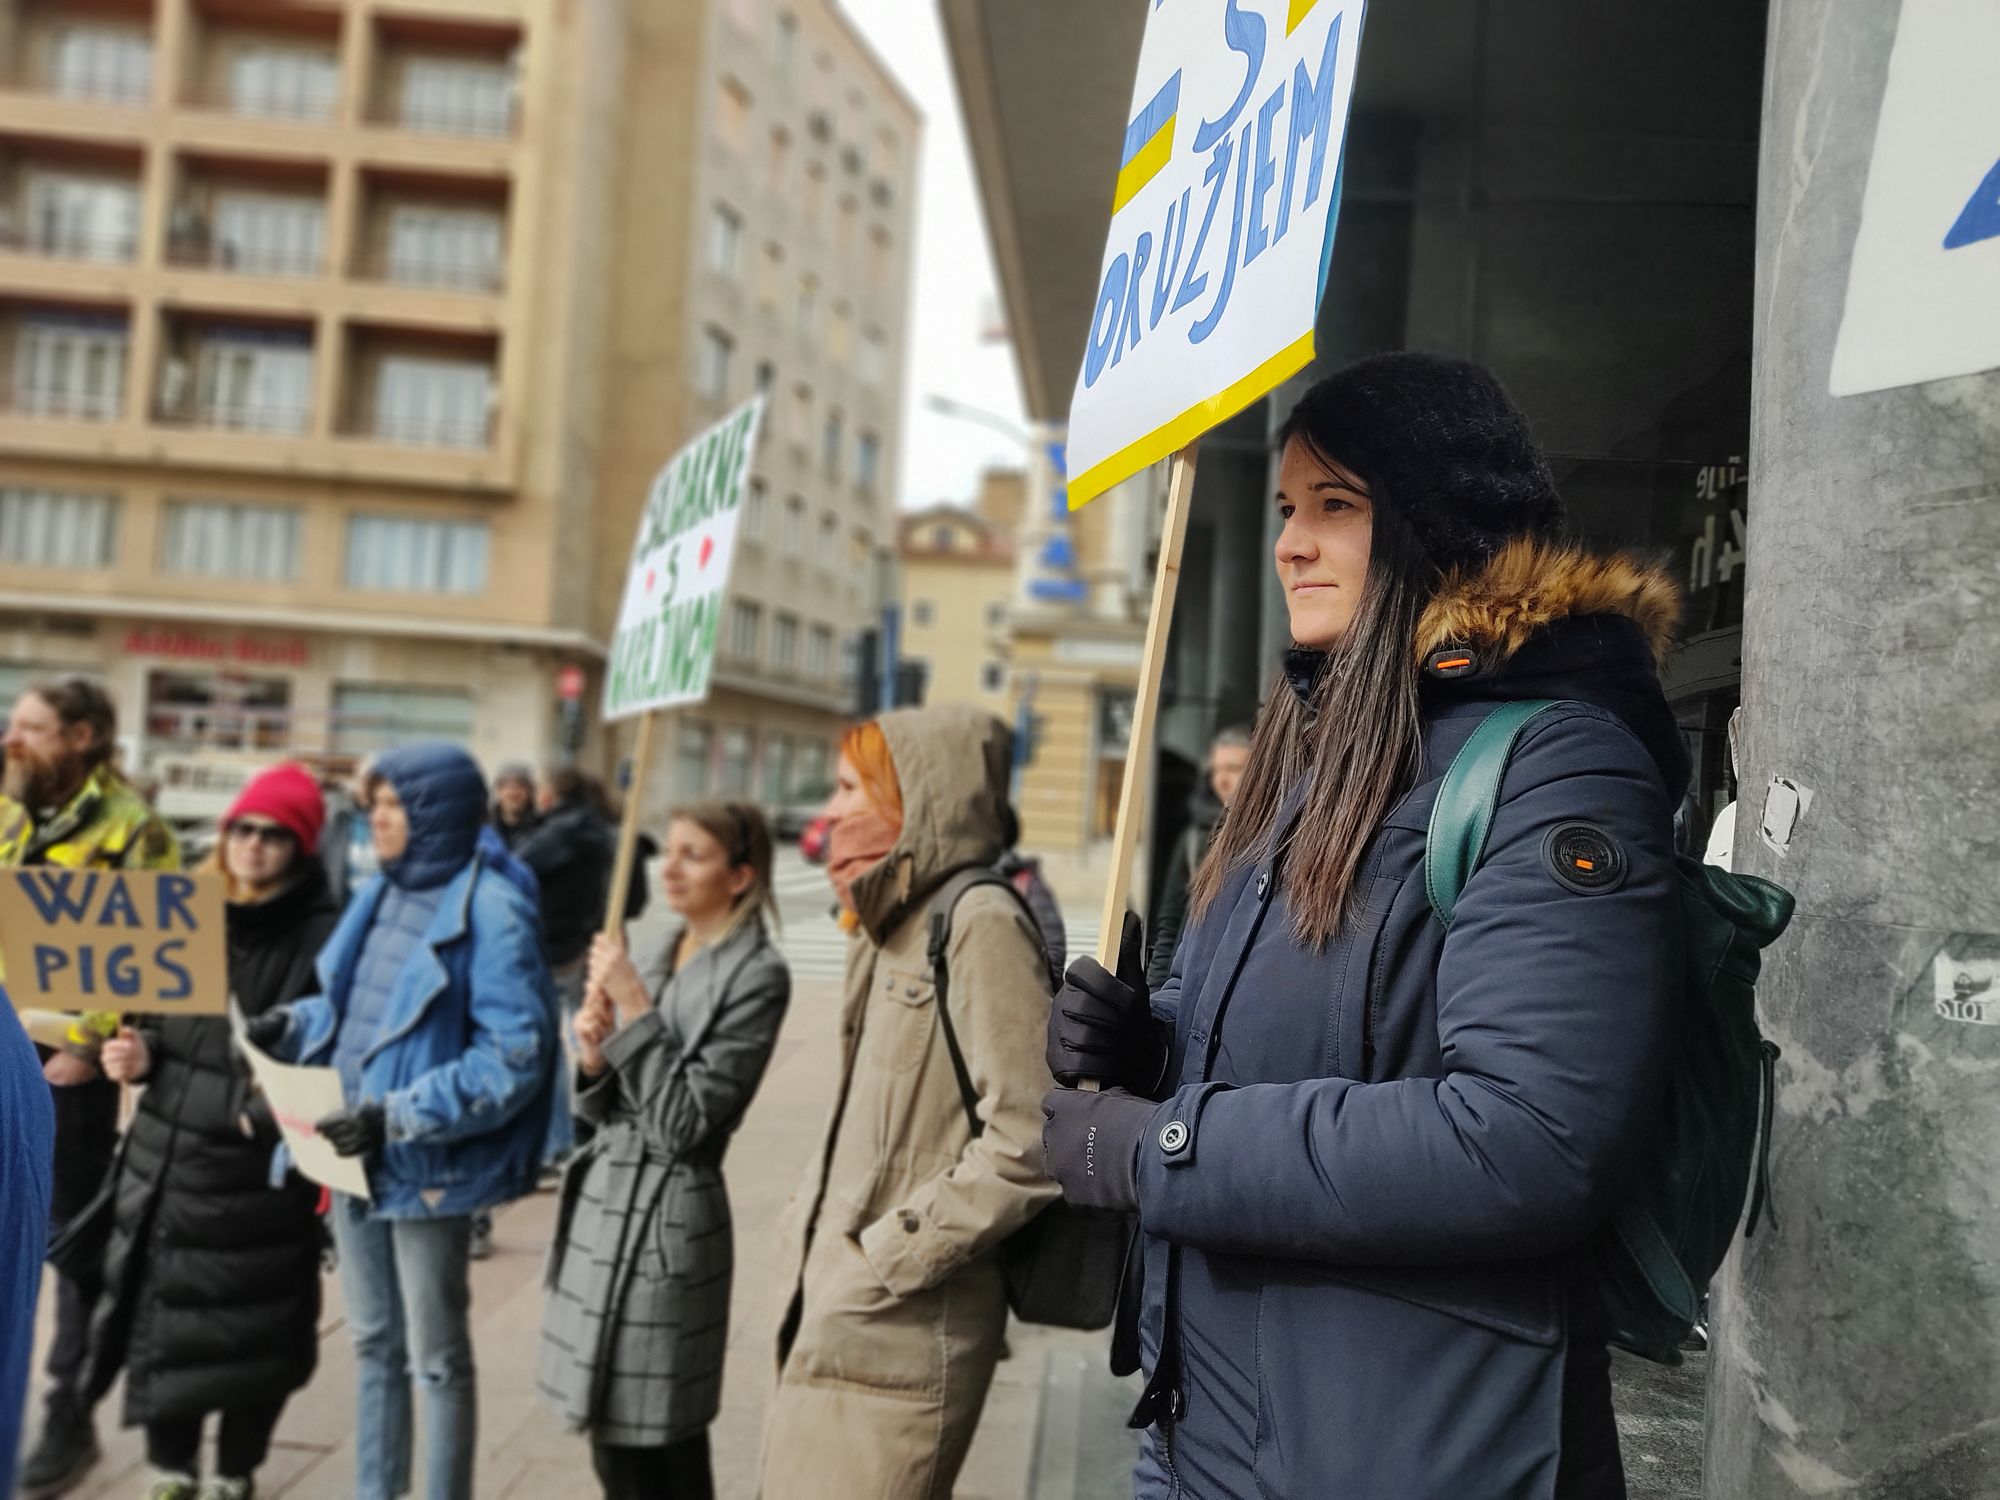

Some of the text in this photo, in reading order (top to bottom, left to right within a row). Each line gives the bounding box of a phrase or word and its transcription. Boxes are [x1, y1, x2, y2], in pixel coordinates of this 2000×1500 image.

[1192, 0, 1268, 154] S
[1084, 10, 1343, 389] ORUŽJEM
[16, 871, 198, 931] WAR
[34, 939, 193, 1000] PIGS
[1086, 1126, 1097, 1177] FORCLAZ
